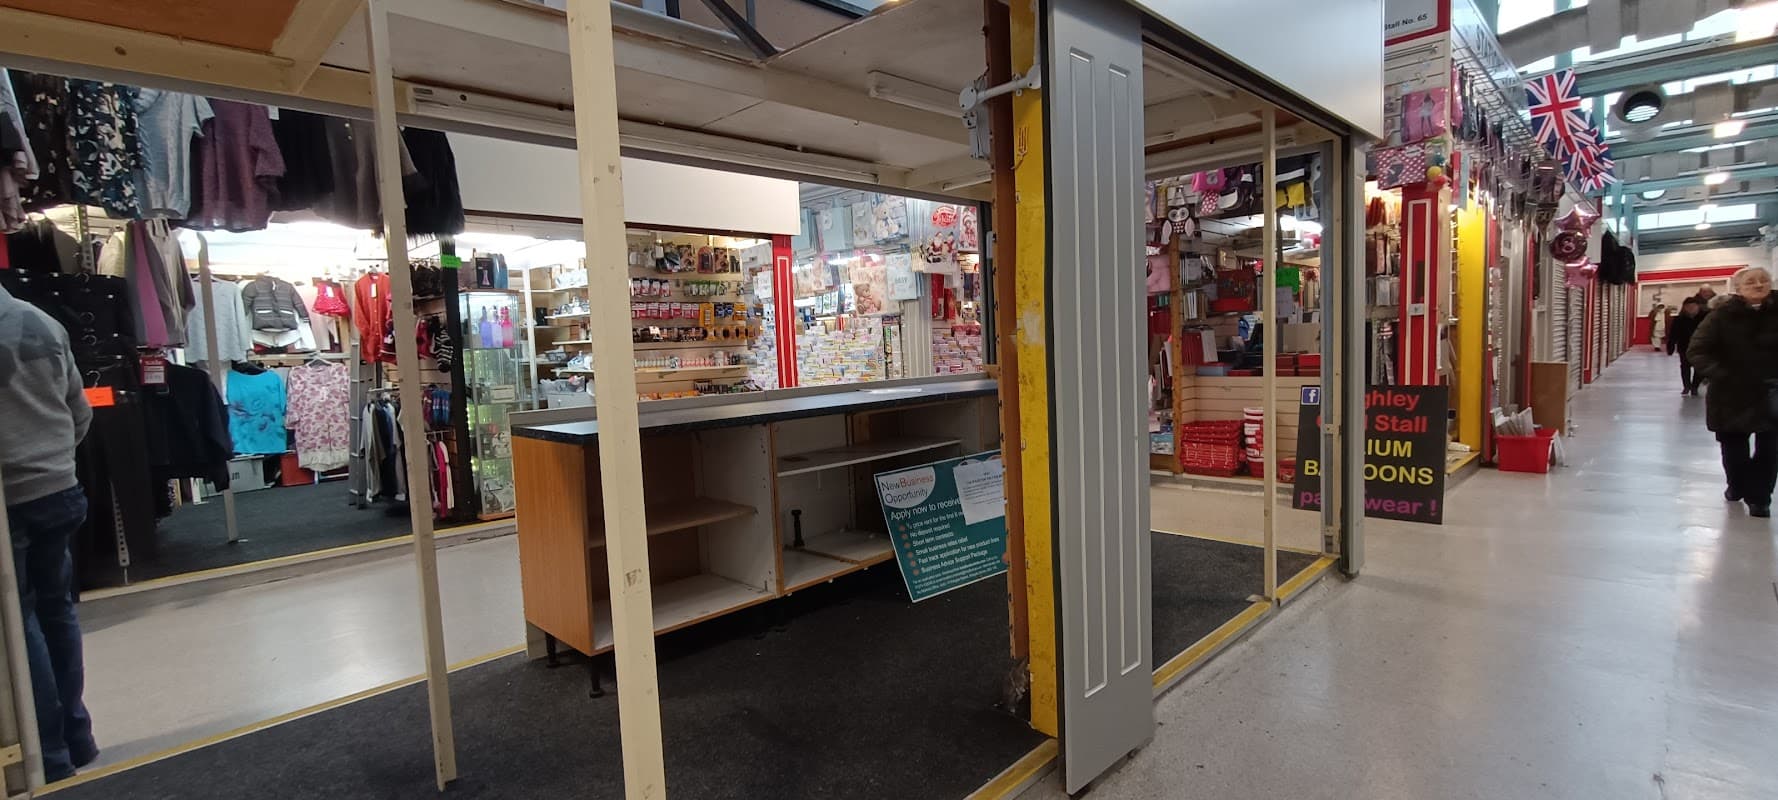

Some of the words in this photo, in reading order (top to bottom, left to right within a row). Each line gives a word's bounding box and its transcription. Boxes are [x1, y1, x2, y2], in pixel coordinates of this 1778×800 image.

[1417, 13, 1428, 22] 65
[1375, 414, 1428, 433] Stall
[885, 488, 928, 504] Opportunity
[890, 508, 911, 521] Apply
[912, 506, 928, 516] now
[929, 503, 936, 511] to
[913, 521, 923, 529] price
[917, 528, 933, 536] deposit
[933, 523, 950, 532] required
[912, 539, 925, 547] Short
[935, 531, 954, 541] contracts
[915, 548, 928, 556] Small
[928, 543, 947, 552] business
[957, 536, 968, 544] relief
[928, 554, 939, 562] track
[939, 548, 961, 559] application
[976, 539, 991, 548] product
[921, 563, 941, 573] Business
[941, 559, 955, 567] Advice
[954, 553, 971, 563] Support
[970, 549, 988, 558] Package
